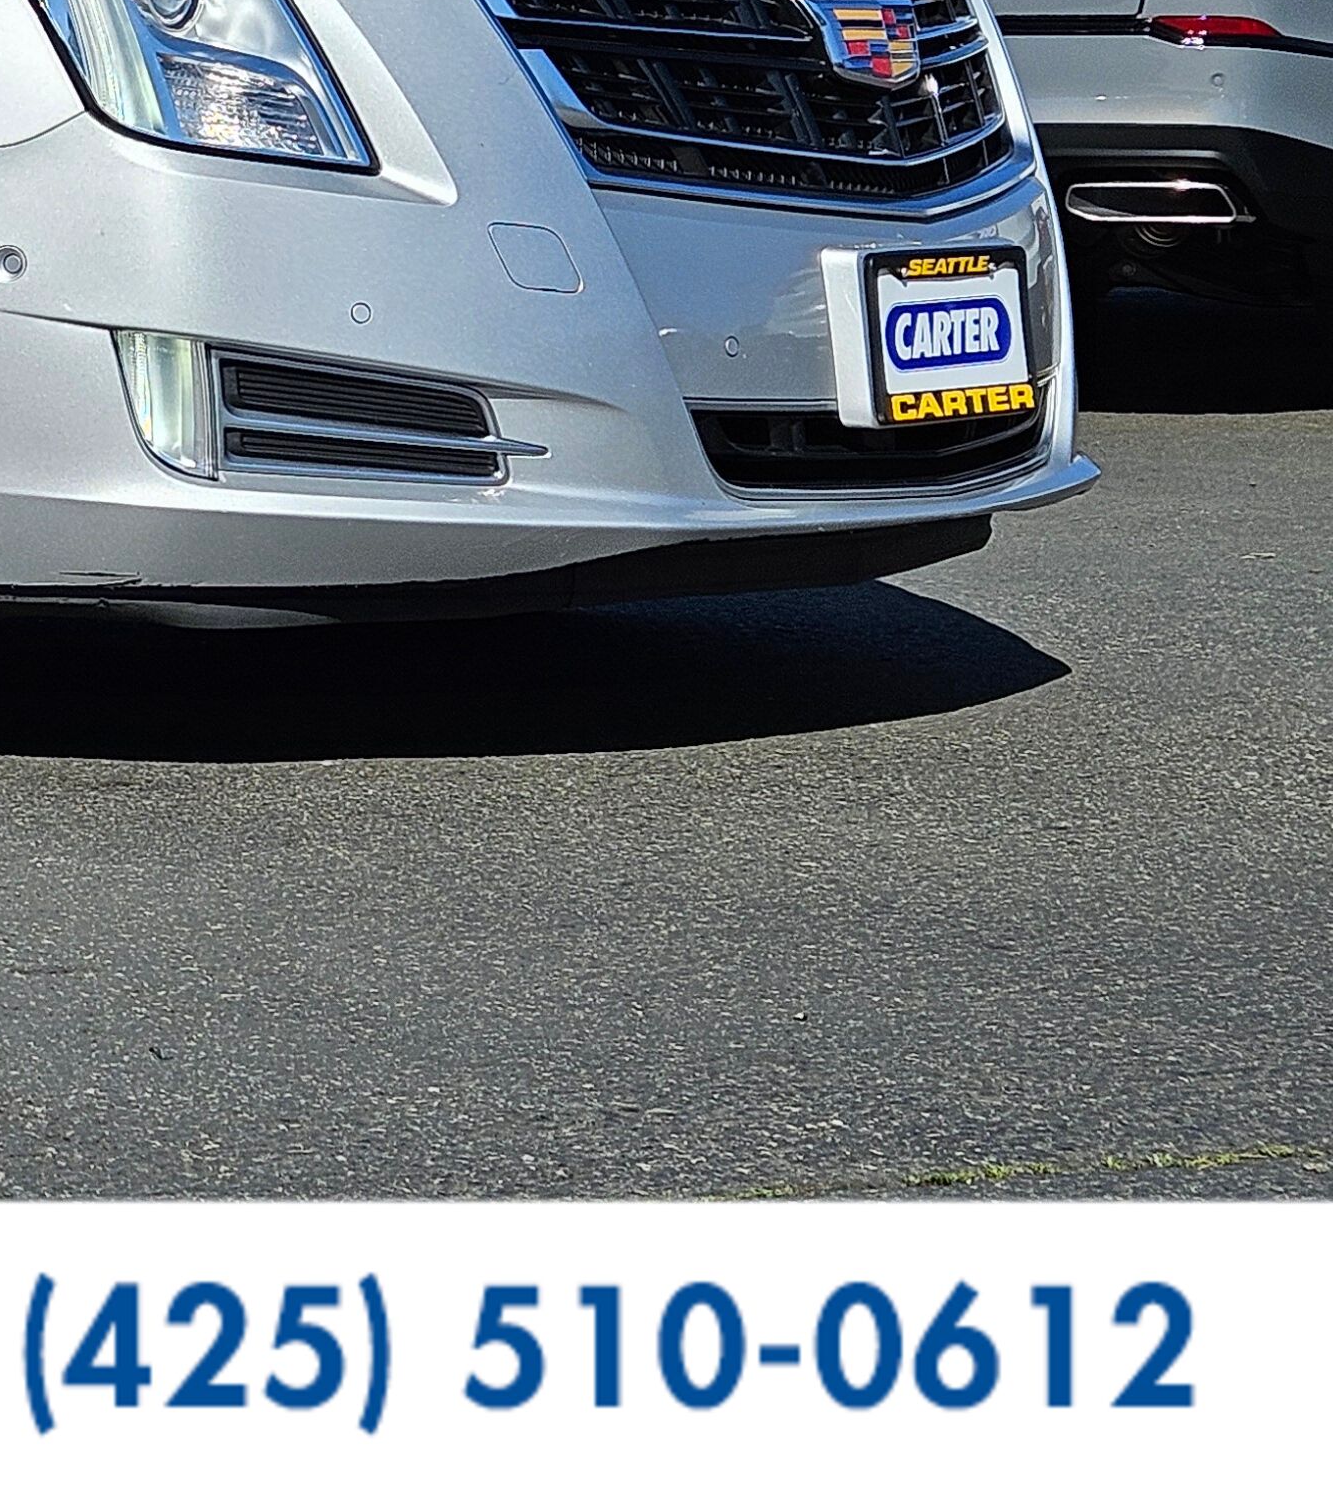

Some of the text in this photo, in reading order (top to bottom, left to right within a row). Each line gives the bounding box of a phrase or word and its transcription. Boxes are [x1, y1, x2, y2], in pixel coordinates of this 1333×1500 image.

[907, 255, 990, 276] SEATTLE
[894, 306, 1000, 361] CARTER
[891, 384, 1035, 421] CARTER
